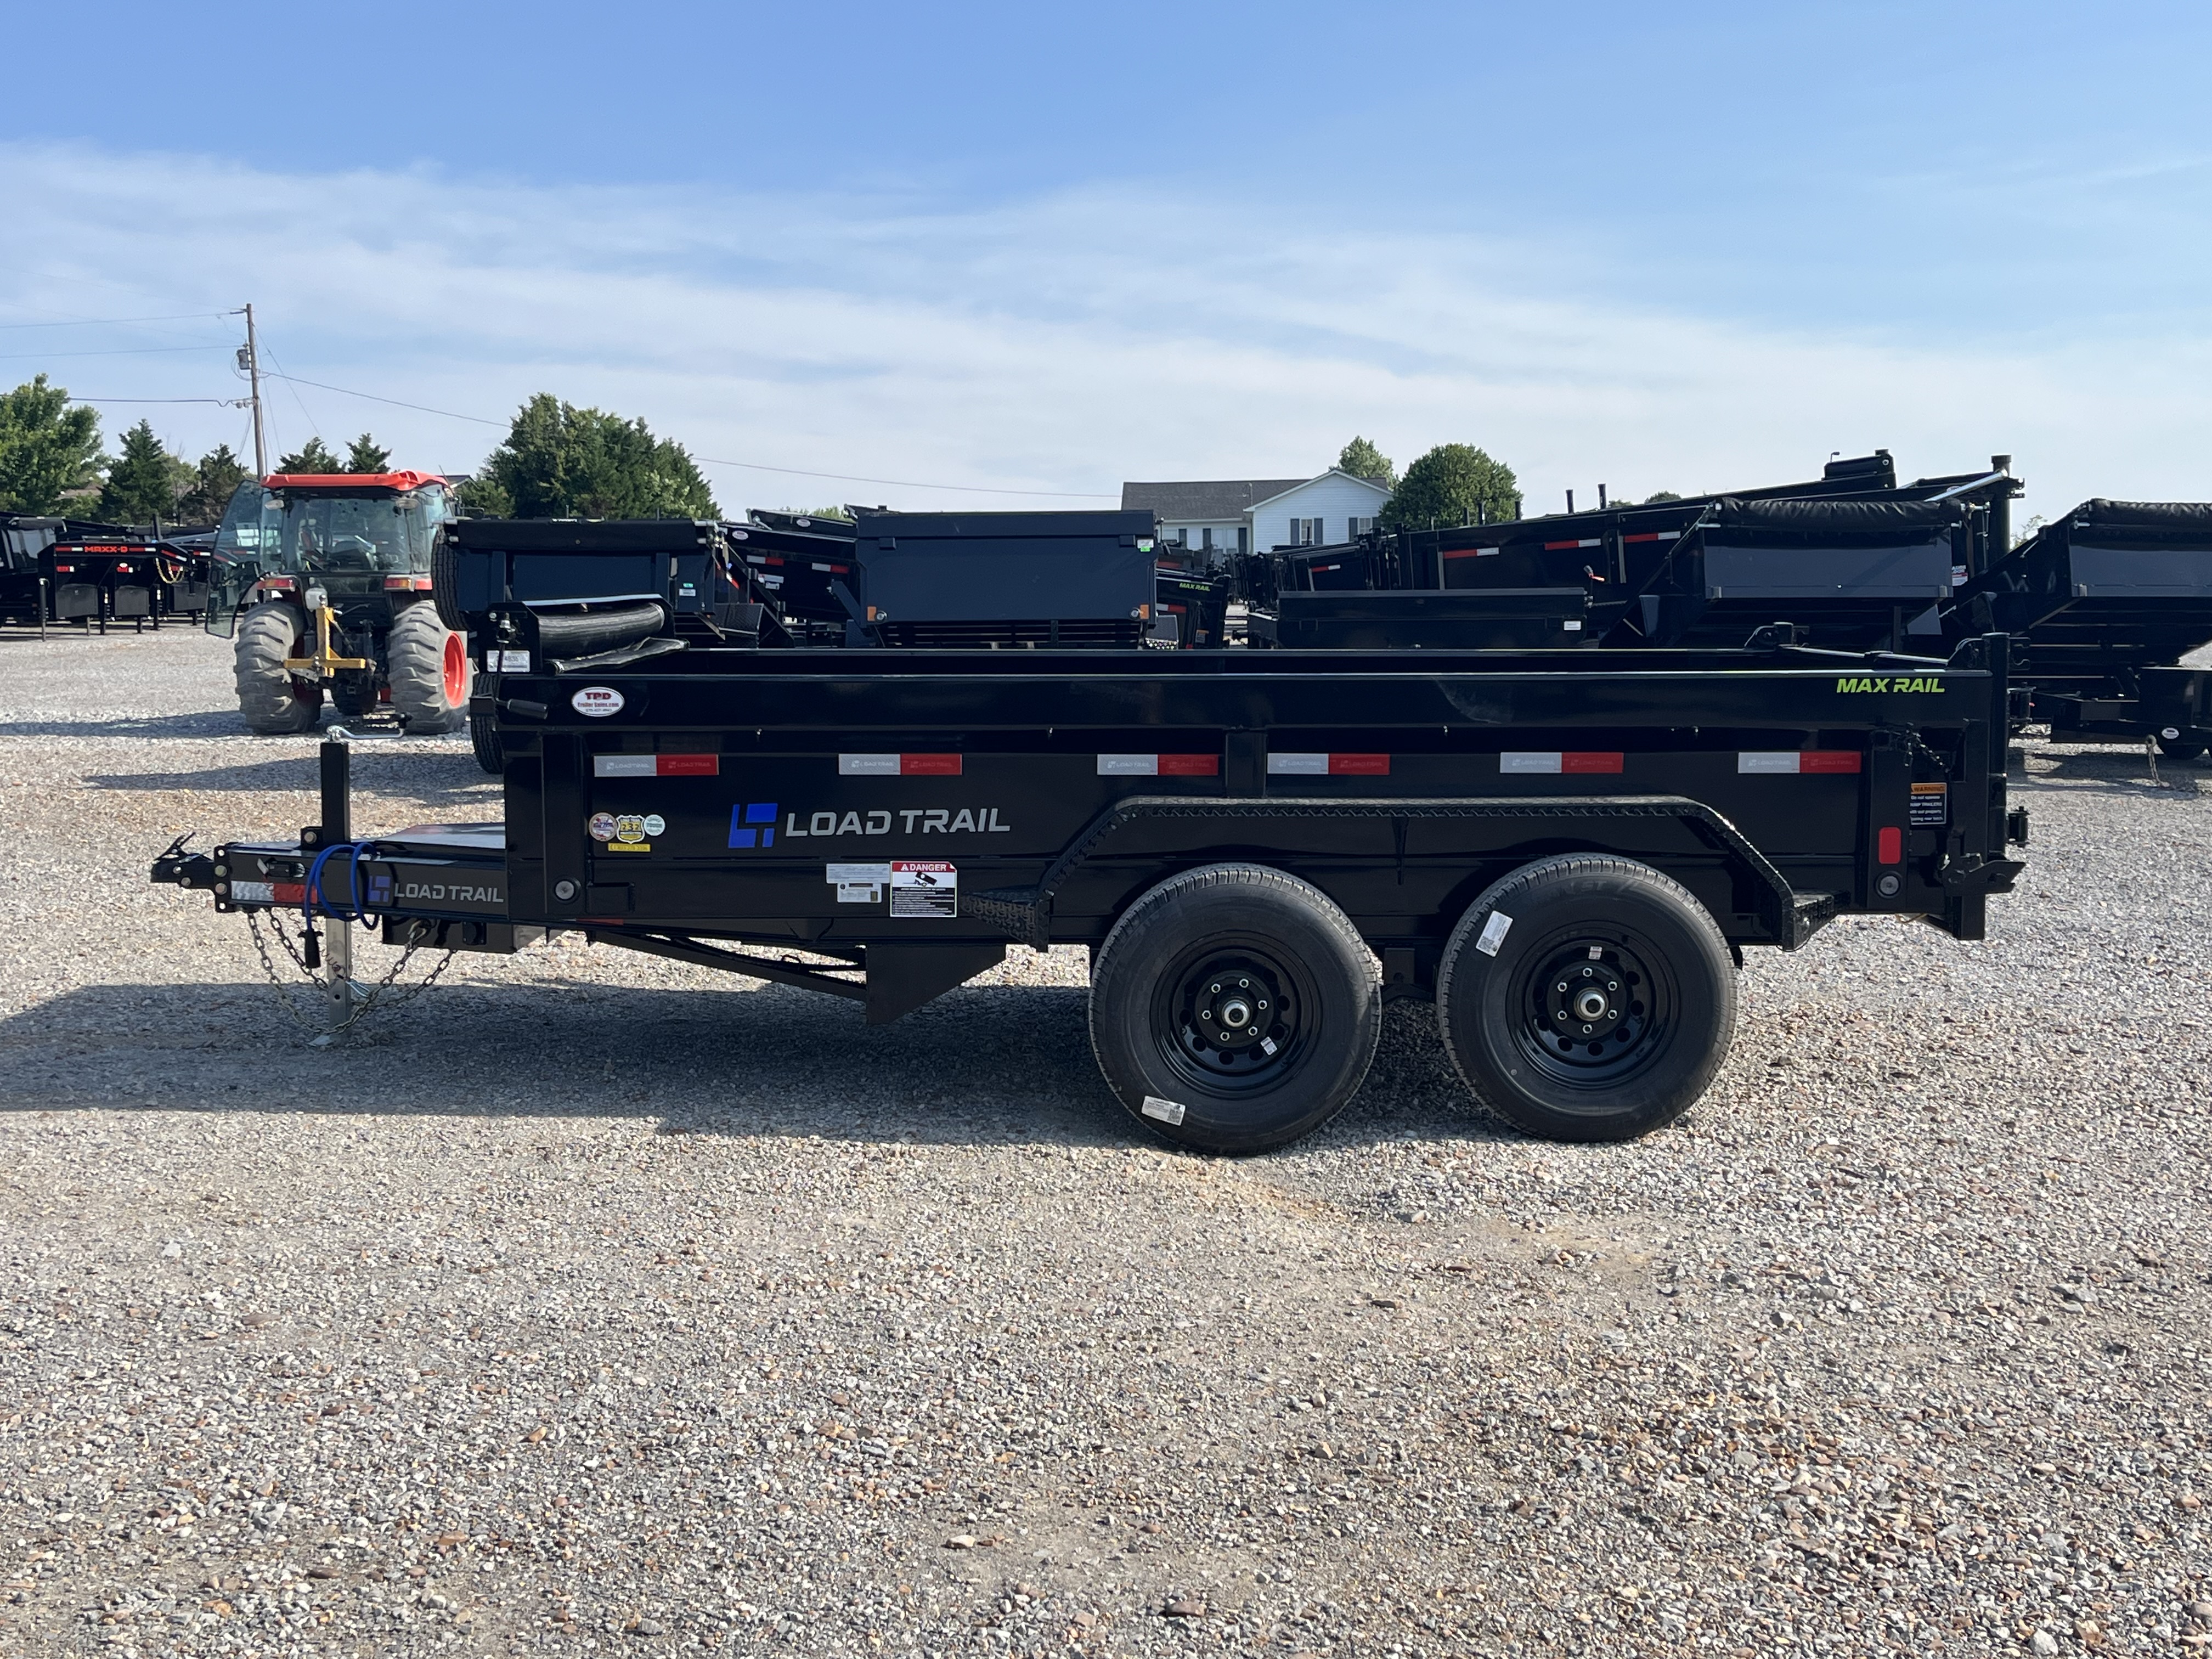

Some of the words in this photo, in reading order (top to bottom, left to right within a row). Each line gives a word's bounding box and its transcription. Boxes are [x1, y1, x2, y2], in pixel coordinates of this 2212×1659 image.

[1837, 678, 1891, 693] MAX
[1893, 678, 1945, 693] RAIL
[786, 810, 891, 837] LOAD
[899, 808, 1011, 834] TRAIL
[394, 883, 445, 899] LOAD
[448, 885, 504, 902] TRAIL
